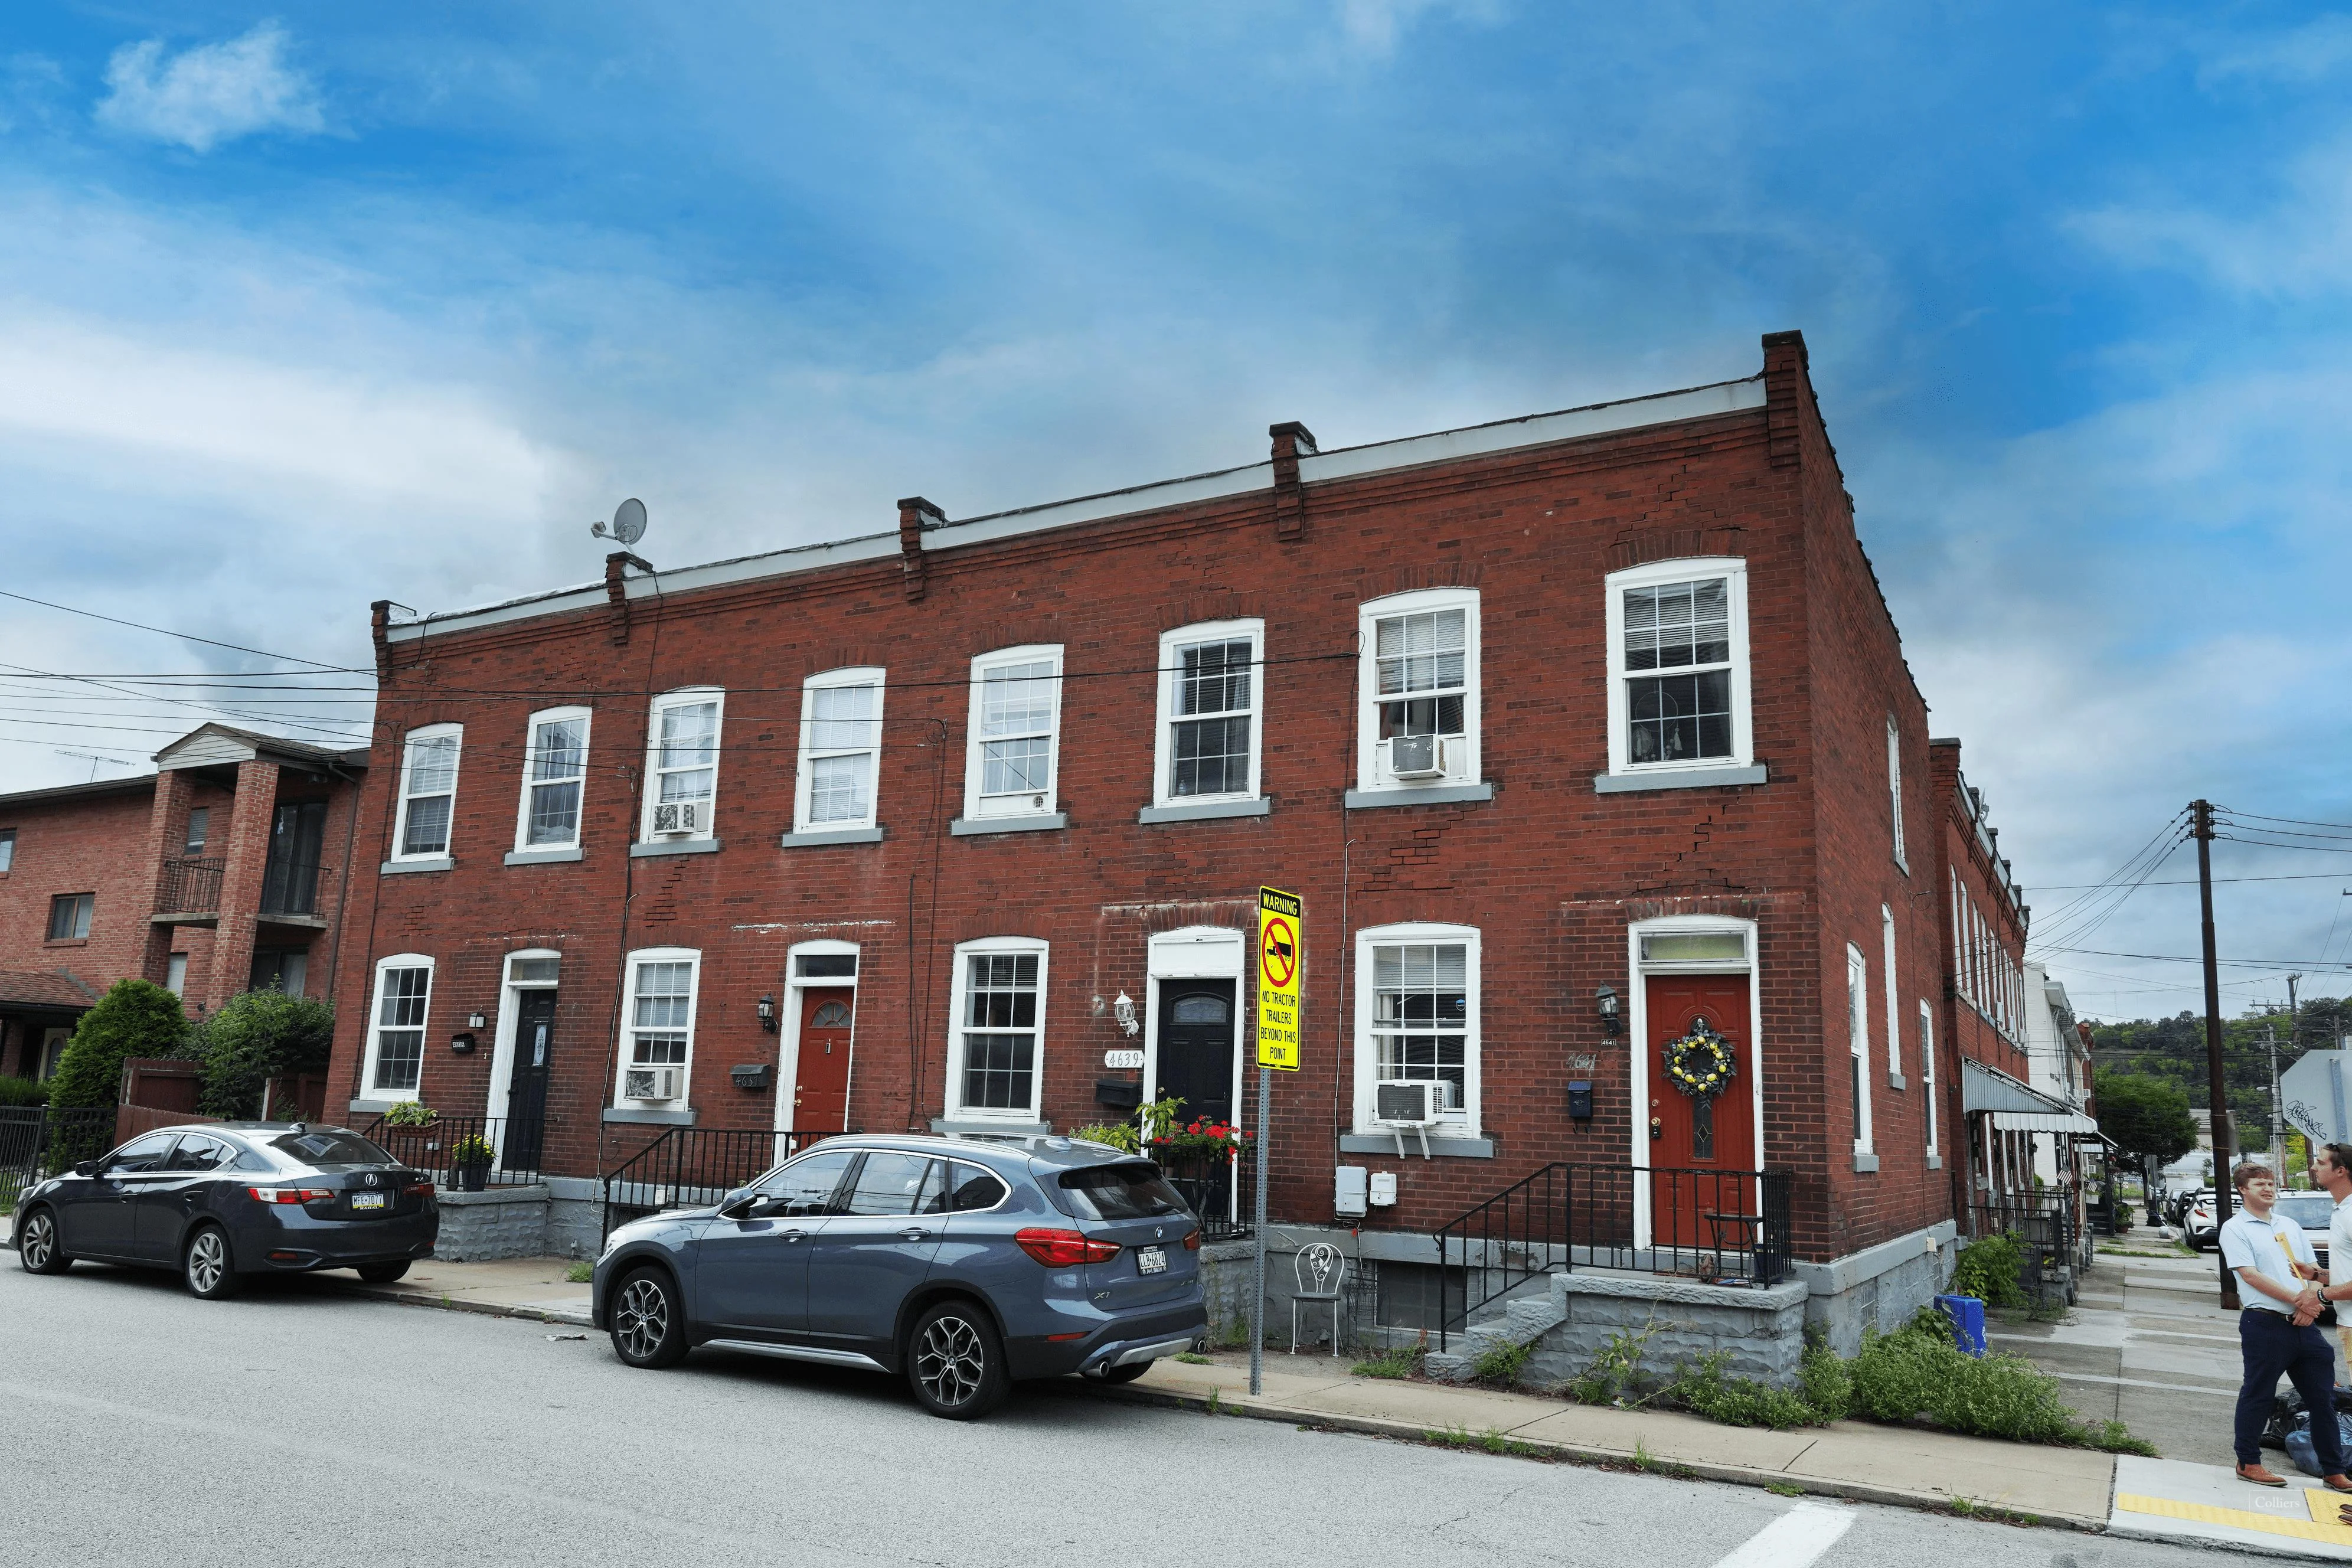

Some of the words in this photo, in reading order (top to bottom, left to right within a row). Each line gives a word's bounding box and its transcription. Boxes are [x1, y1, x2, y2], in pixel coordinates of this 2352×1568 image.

[1263, 893, 1297, 916] WARNING
[1262, 990, 1269, 1002] NO
[1272, 992, 1296, 1007] TRACTOR
[1266, 1009, 1292, 1025] TRAILERS
[1260, 1027, 1282, 1041] BEYOND
[1284, 1030, 1296, 1044] THIS
[1109, 1052, 1139, 1066] 4639
[1270, 1047, 1286, 1060] POINT
